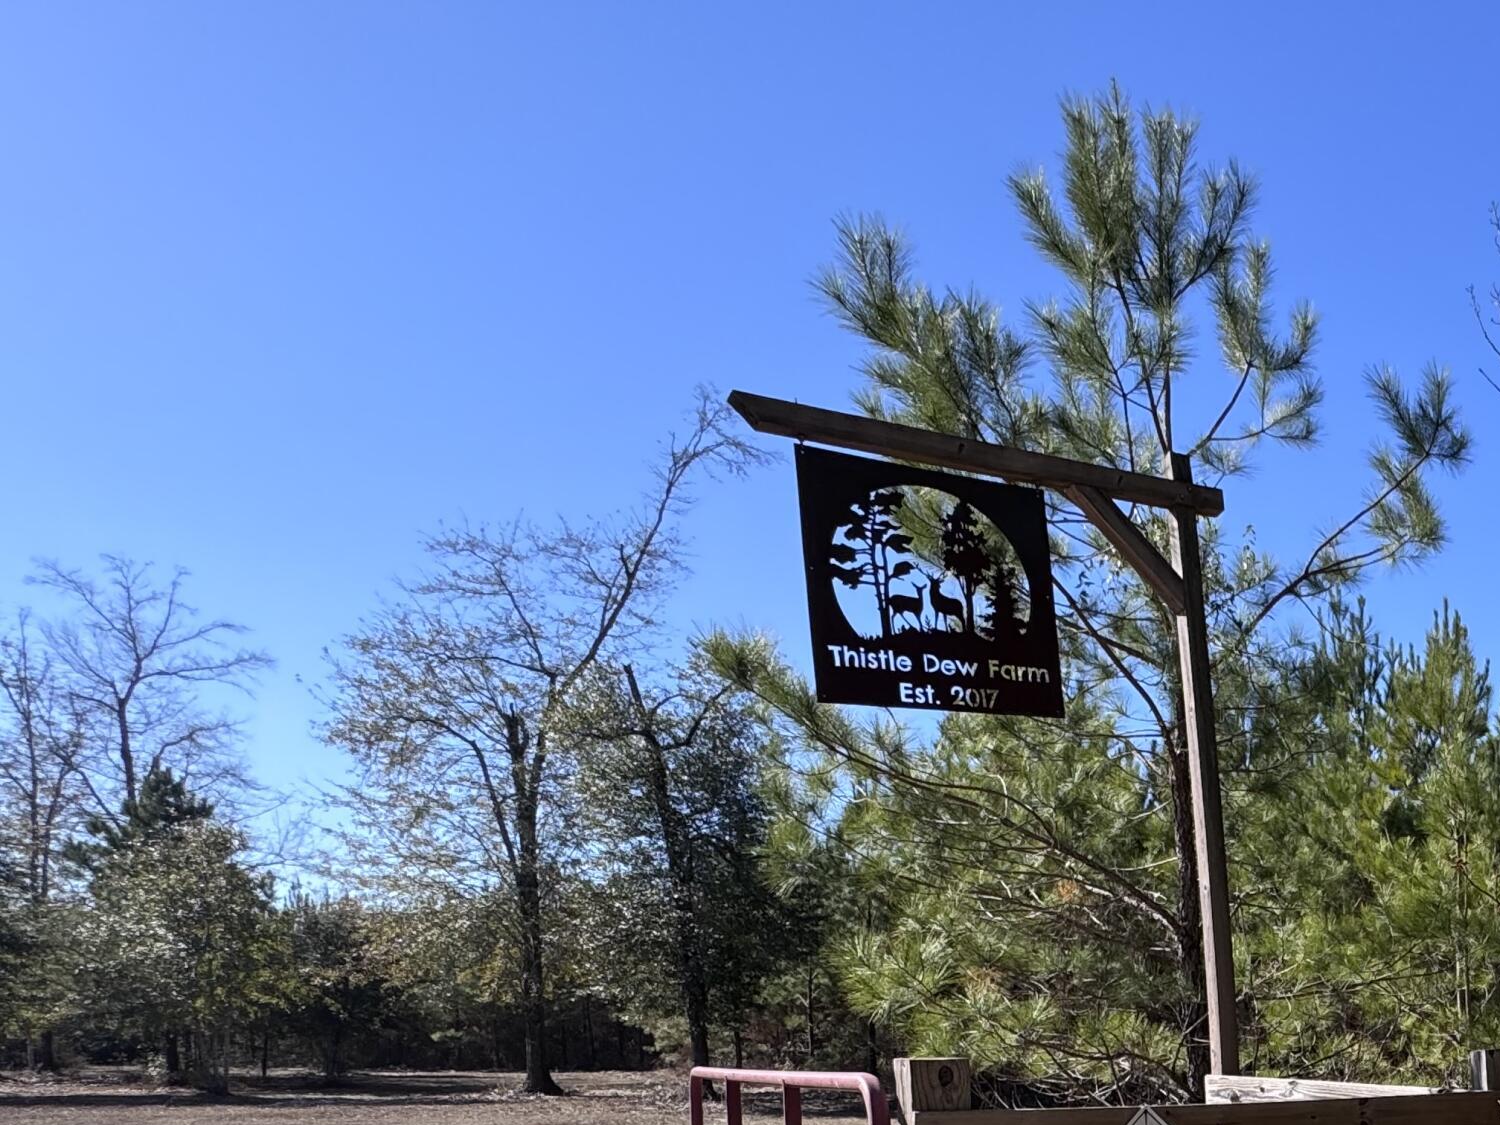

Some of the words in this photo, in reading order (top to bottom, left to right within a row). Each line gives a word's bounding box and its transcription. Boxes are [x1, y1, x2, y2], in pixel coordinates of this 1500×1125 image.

[827, 645, 912, 673] Thistle
[923, 654, 978, 678] Dew
[988, 659, 1050, 684] Farm
[899, 682, 941, 705] Est.
[951, 686, 999, 709] 2017
